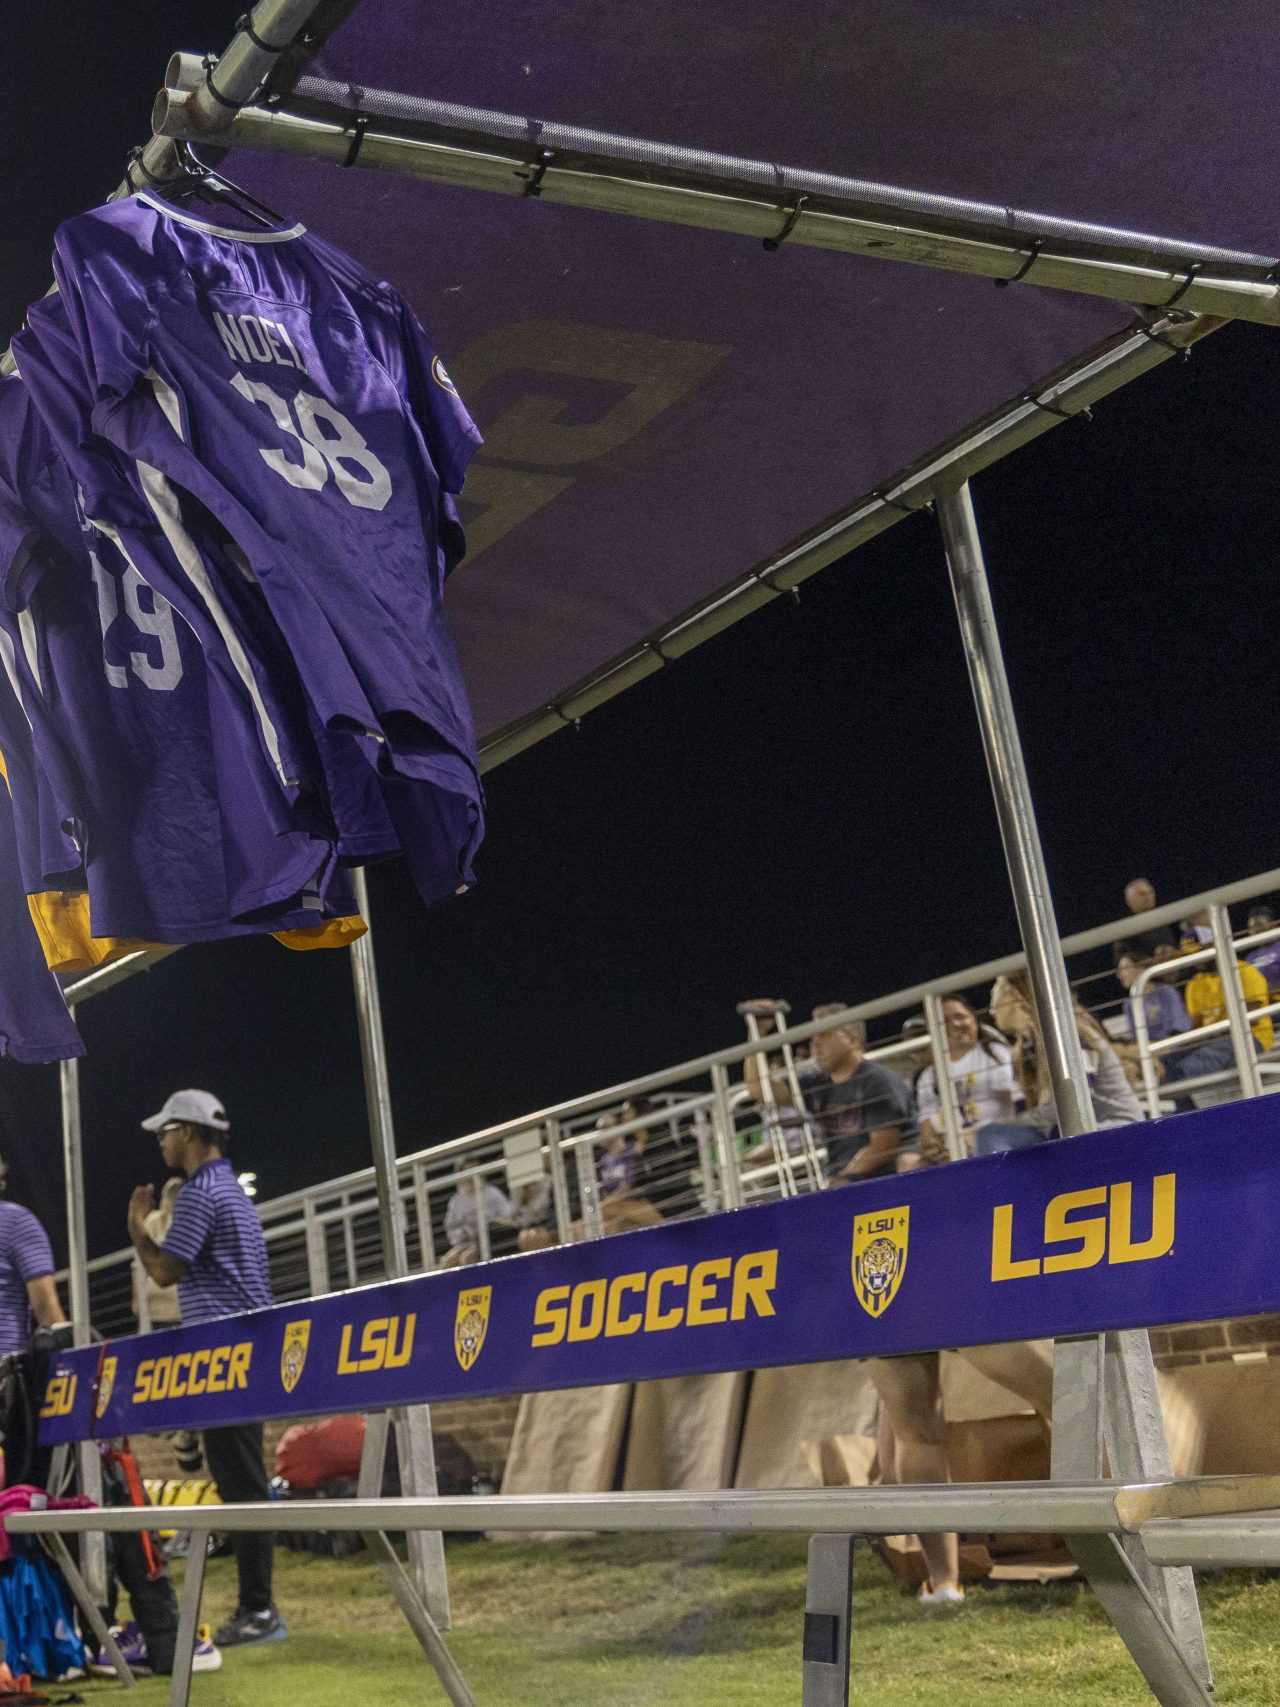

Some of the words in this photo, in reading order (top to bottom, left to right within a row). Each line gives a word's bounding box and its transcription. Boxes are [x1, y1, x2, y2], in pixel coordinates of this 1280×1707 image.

[213, 311, 308, 371] NOEL
[231, 371, 392, 511] 38
[89, 551, 184, 691] 19
[868, 1217, 894, 1234] LSU
[991, 1173, 1176, 1282] LSU
[465, 1294, 483, 1307] LSU
[531, 1249, 779, 1348] SOCCER
[132, 1341, 254, 1404] SOCCER
[337, 1312, 417, 1376] LSU
[40, 1374, 78, 1418] SU
